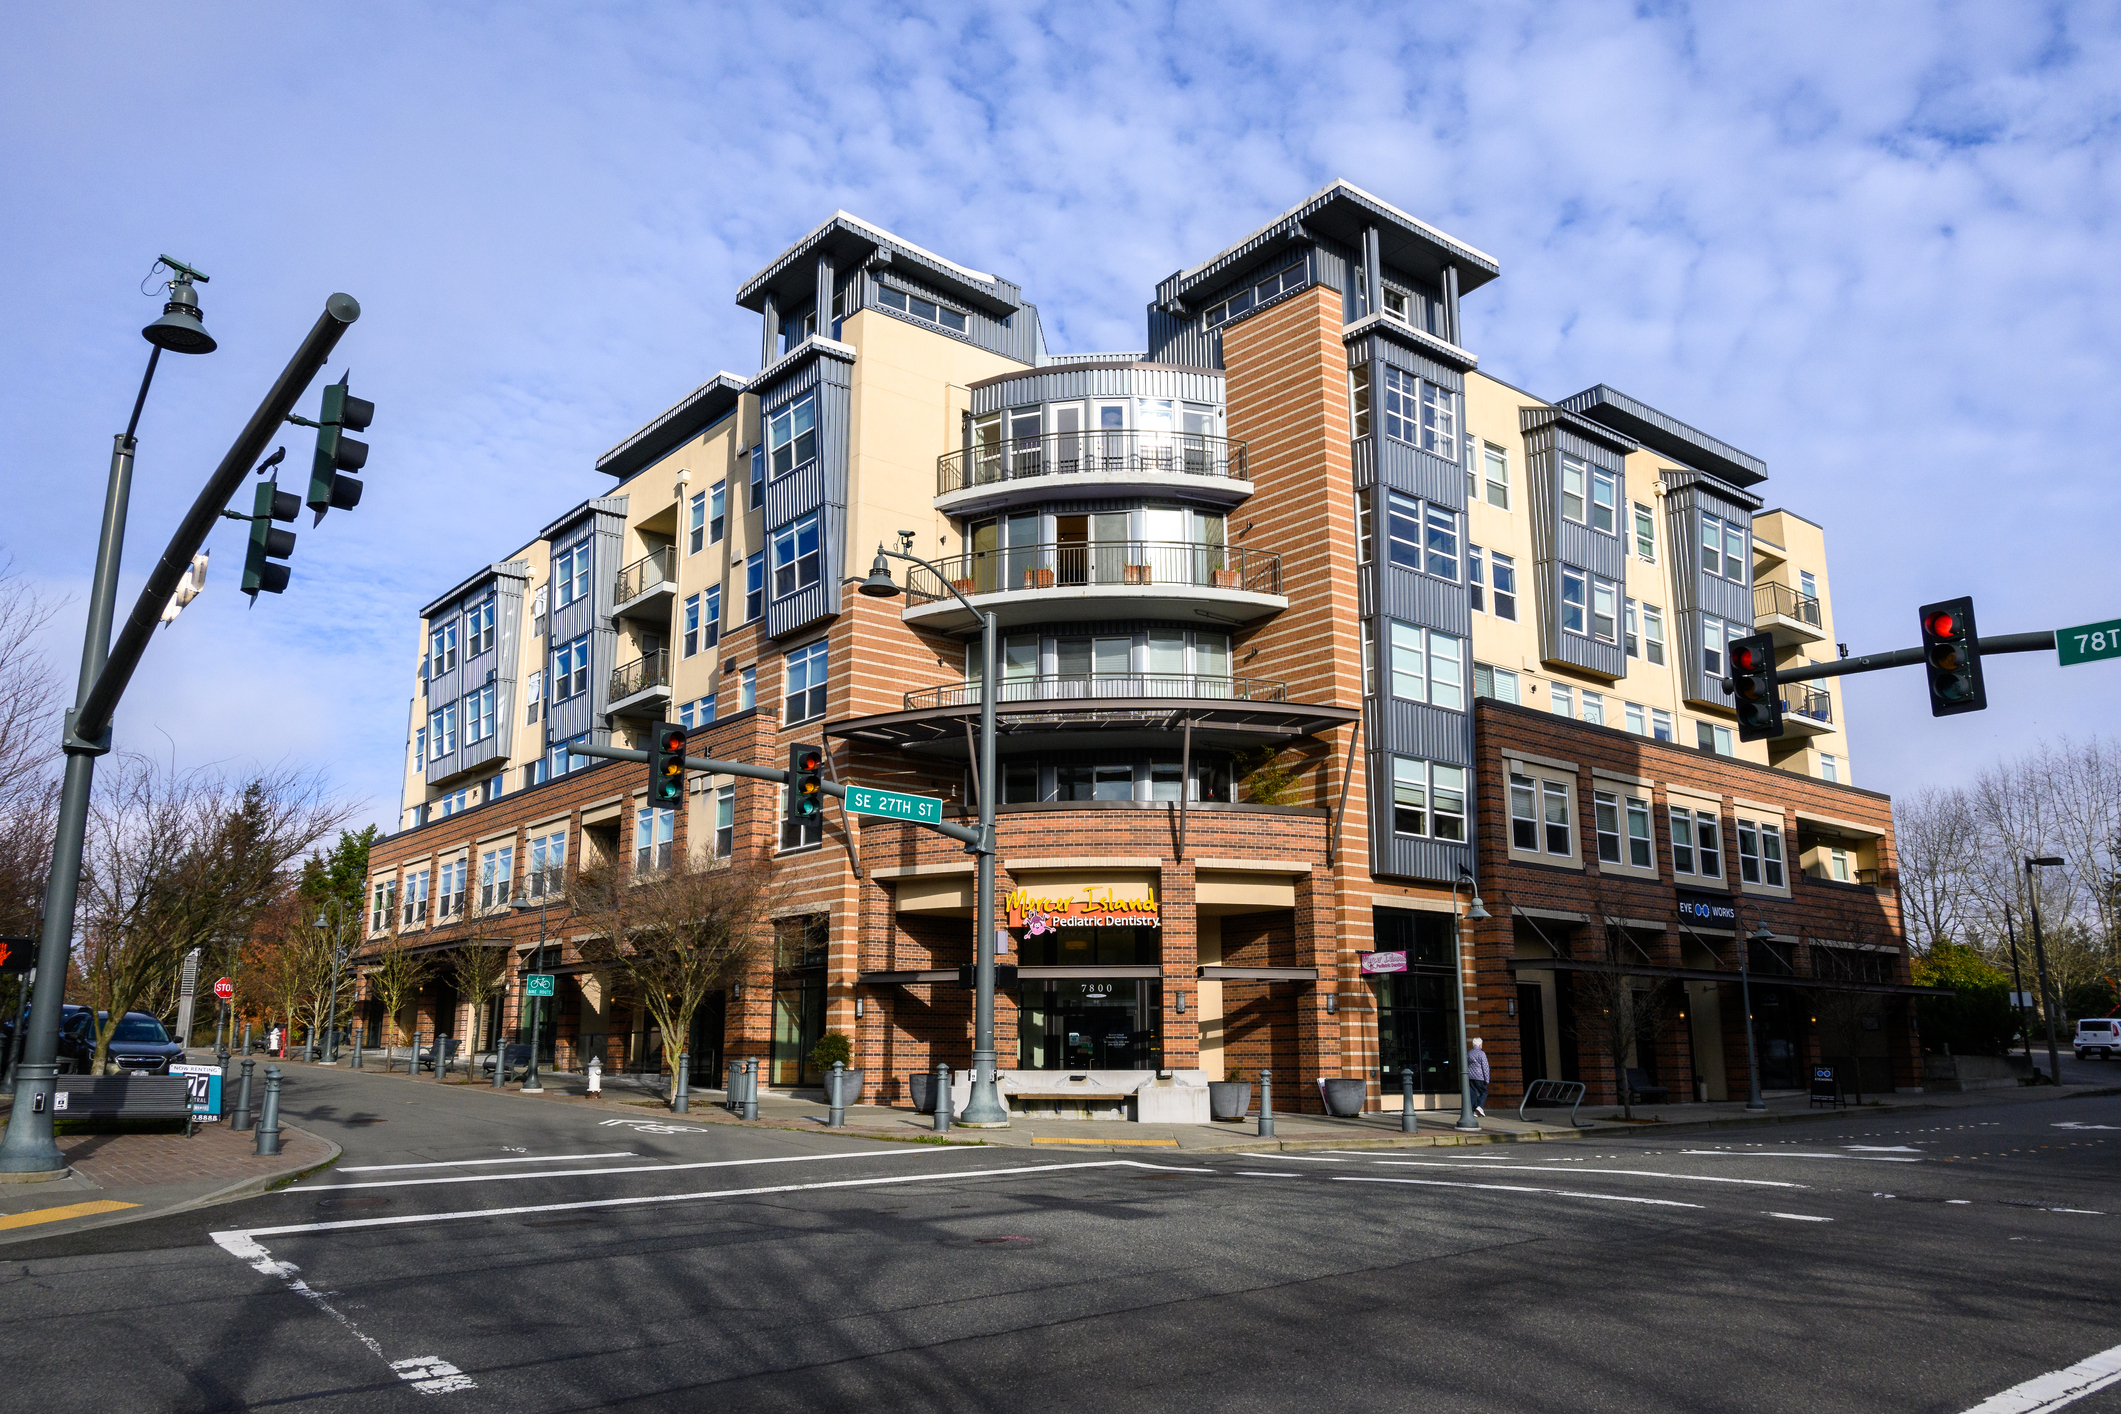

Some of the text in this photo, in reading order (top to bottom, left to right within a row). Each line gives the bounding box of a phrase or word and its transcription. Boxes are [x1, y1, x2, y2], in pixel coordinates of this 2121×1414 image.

[2073, 628, 2120, 654] 78T
[855, 793, 934, 817] SE 27TH ST
[1005, 886, 1158, 918] Mercer Island
[1679, 902, 1735, 918] EYE WORKS
[1052, 915, 1160, 929] Pediatric Dentistry
[1081, 984, 1113, 993] 7800
